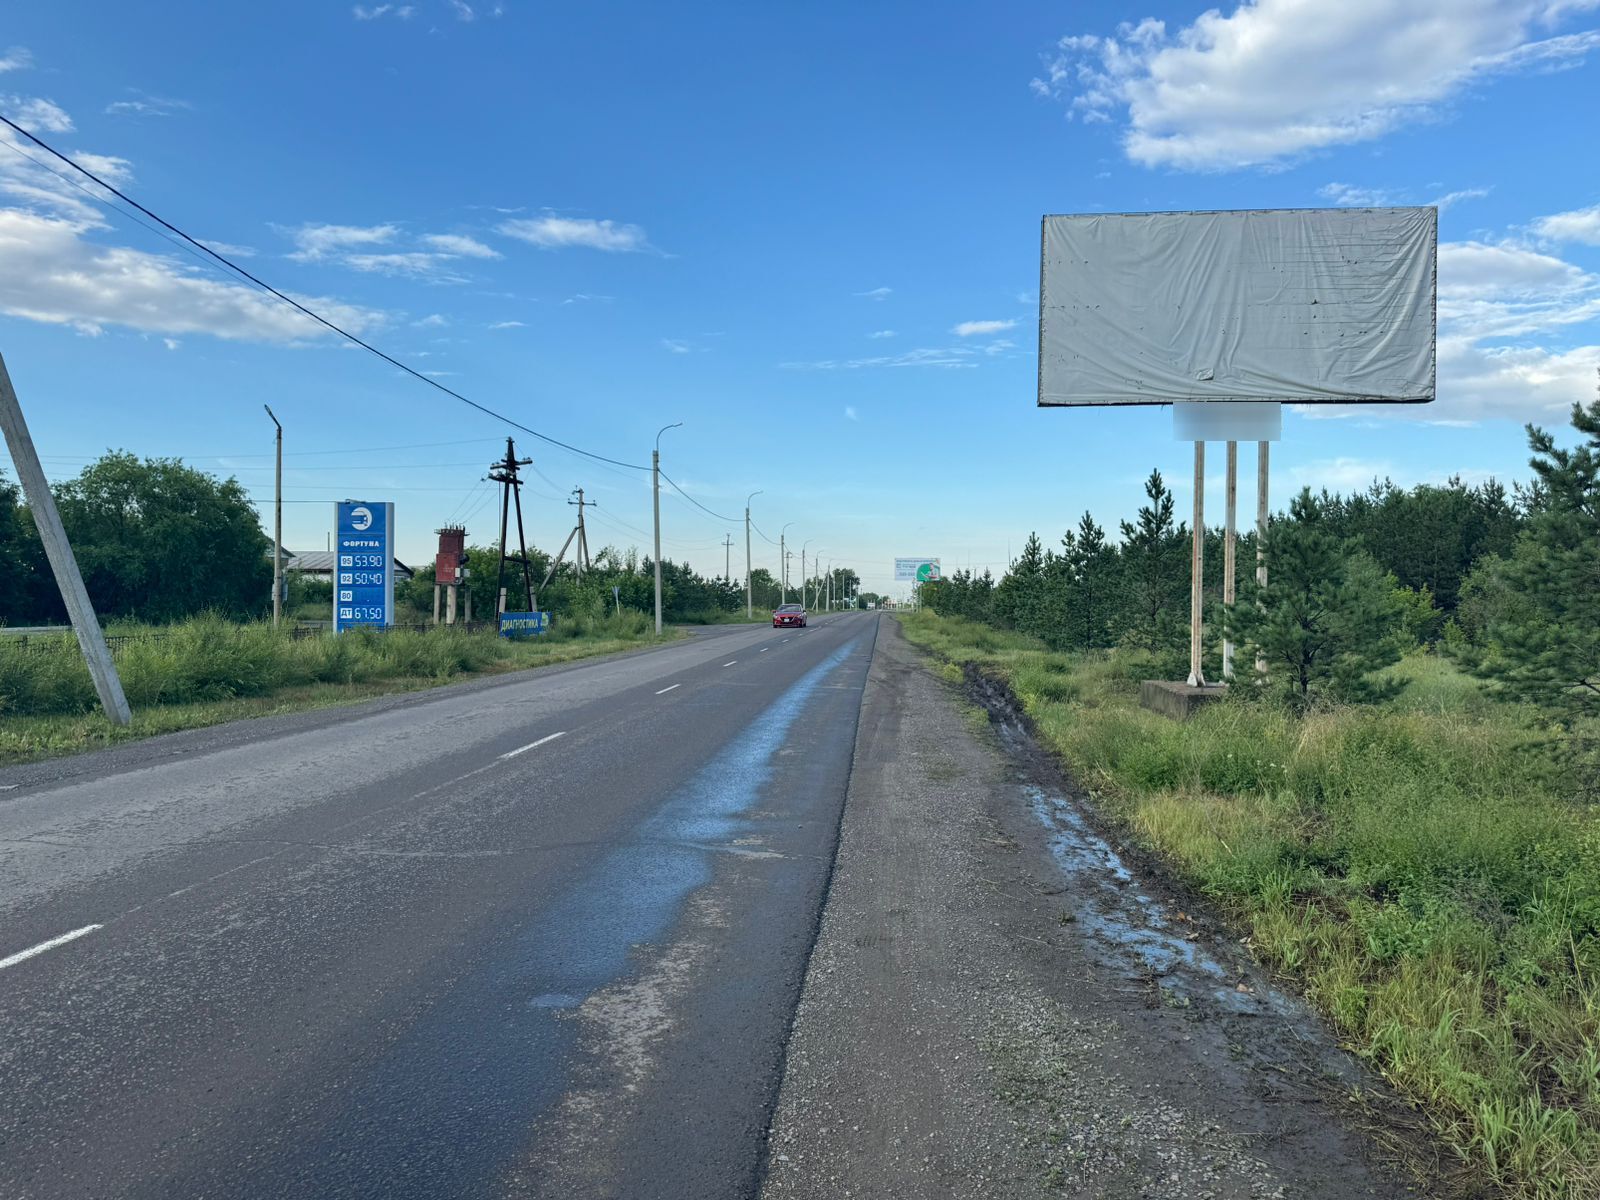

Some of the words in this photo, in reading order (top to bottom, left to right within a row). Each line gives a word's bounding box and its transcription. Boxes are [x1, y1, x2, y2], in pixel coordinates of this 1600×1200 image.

[355, 556, 382, 567] 53.90
[355, 573, 382, 584] 50.40
[341, 609, 352, 617] ДТ
[355, 608, 382, 619] 67.50
[501, 619, 538, 632] ДИАГНОСТИКА
